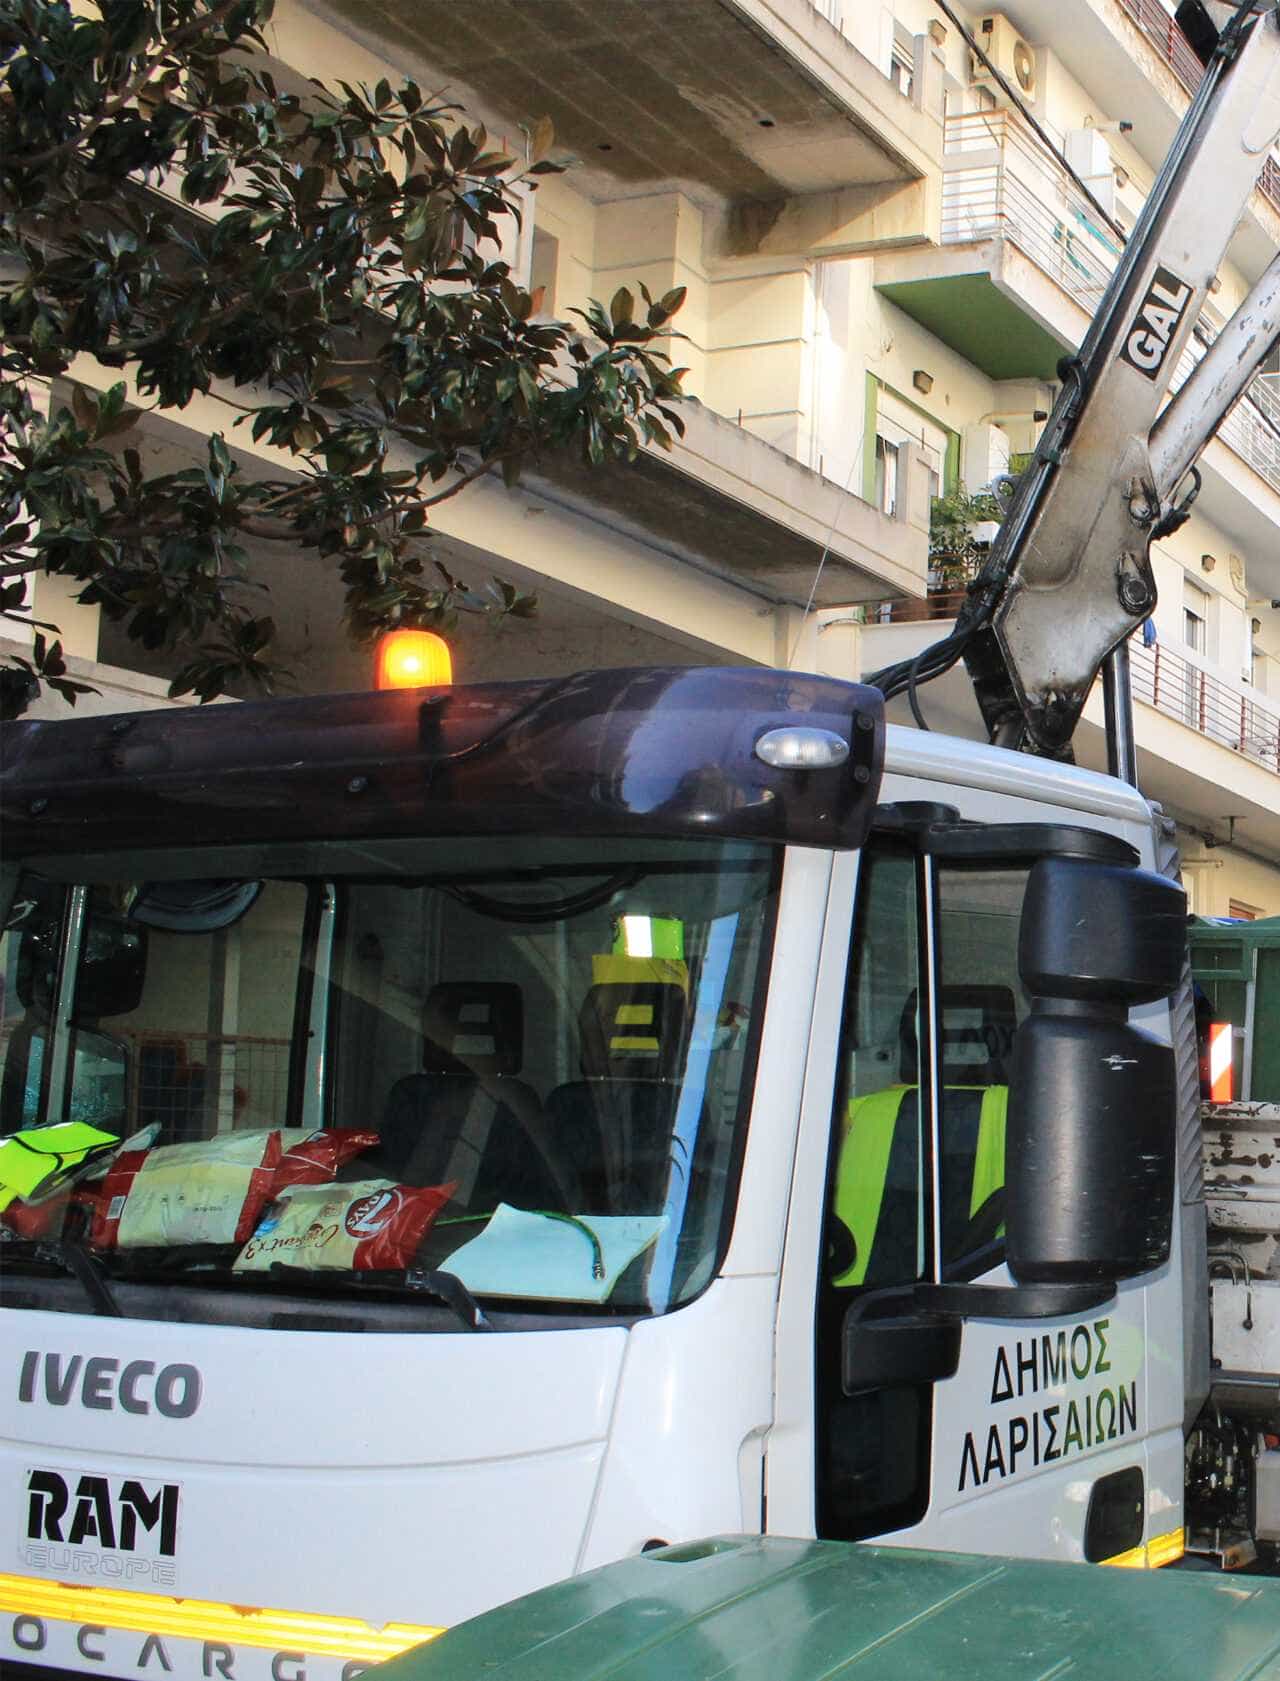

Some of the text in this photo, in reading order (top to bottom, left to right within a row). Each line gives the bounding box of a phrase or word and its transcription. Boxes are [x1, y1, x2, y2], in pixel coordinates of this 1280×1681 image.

[1127, 281, 1190, 370] GAL
[18, 1350, 203, 1419] IVECO
[990, 1319, 1111, 1404] ΔΗΜΟΣ
[957, 1381, 1137, 1492] ΛΑΡΙΣΑΙΩΝ
[27, 1469, 180, 1556] RAM
[24, 1543, 176, 1586] EUROPE
